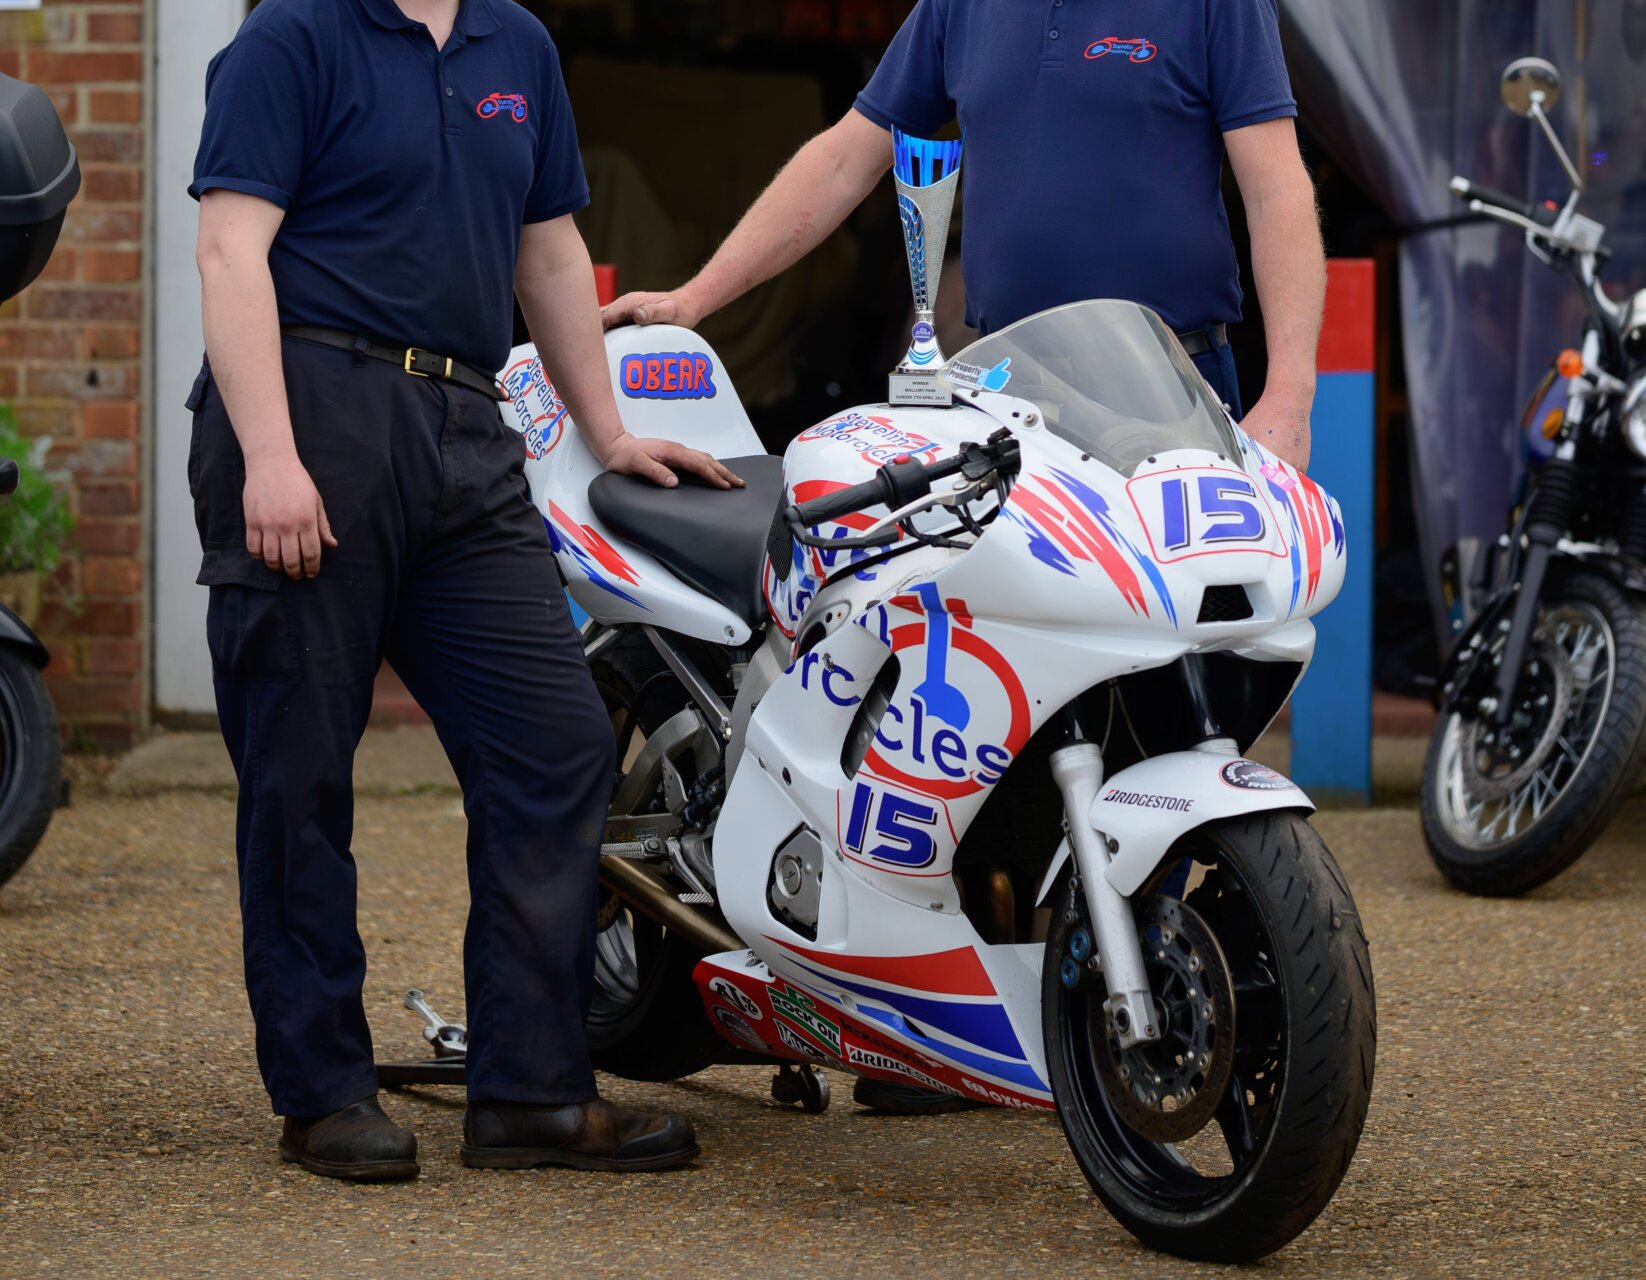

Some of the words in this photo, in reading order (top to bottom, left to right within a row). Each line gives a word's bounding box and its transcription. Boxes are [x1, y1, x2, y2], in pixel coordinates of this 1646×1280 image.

[624, 356, 711, 393] OBEAR
[505, 370, 546, 462] Motorcycles
[846, 412, 910, 447] Stevelin
[1160, 476, 1267, 551] 15
[845, 782, 938, 869] 15
[1103, 788, 1195, 812] BRIDGESTONE
[770, 994, 815, 1027] ROCK
[817, 1022, 840, 1047] OIL
